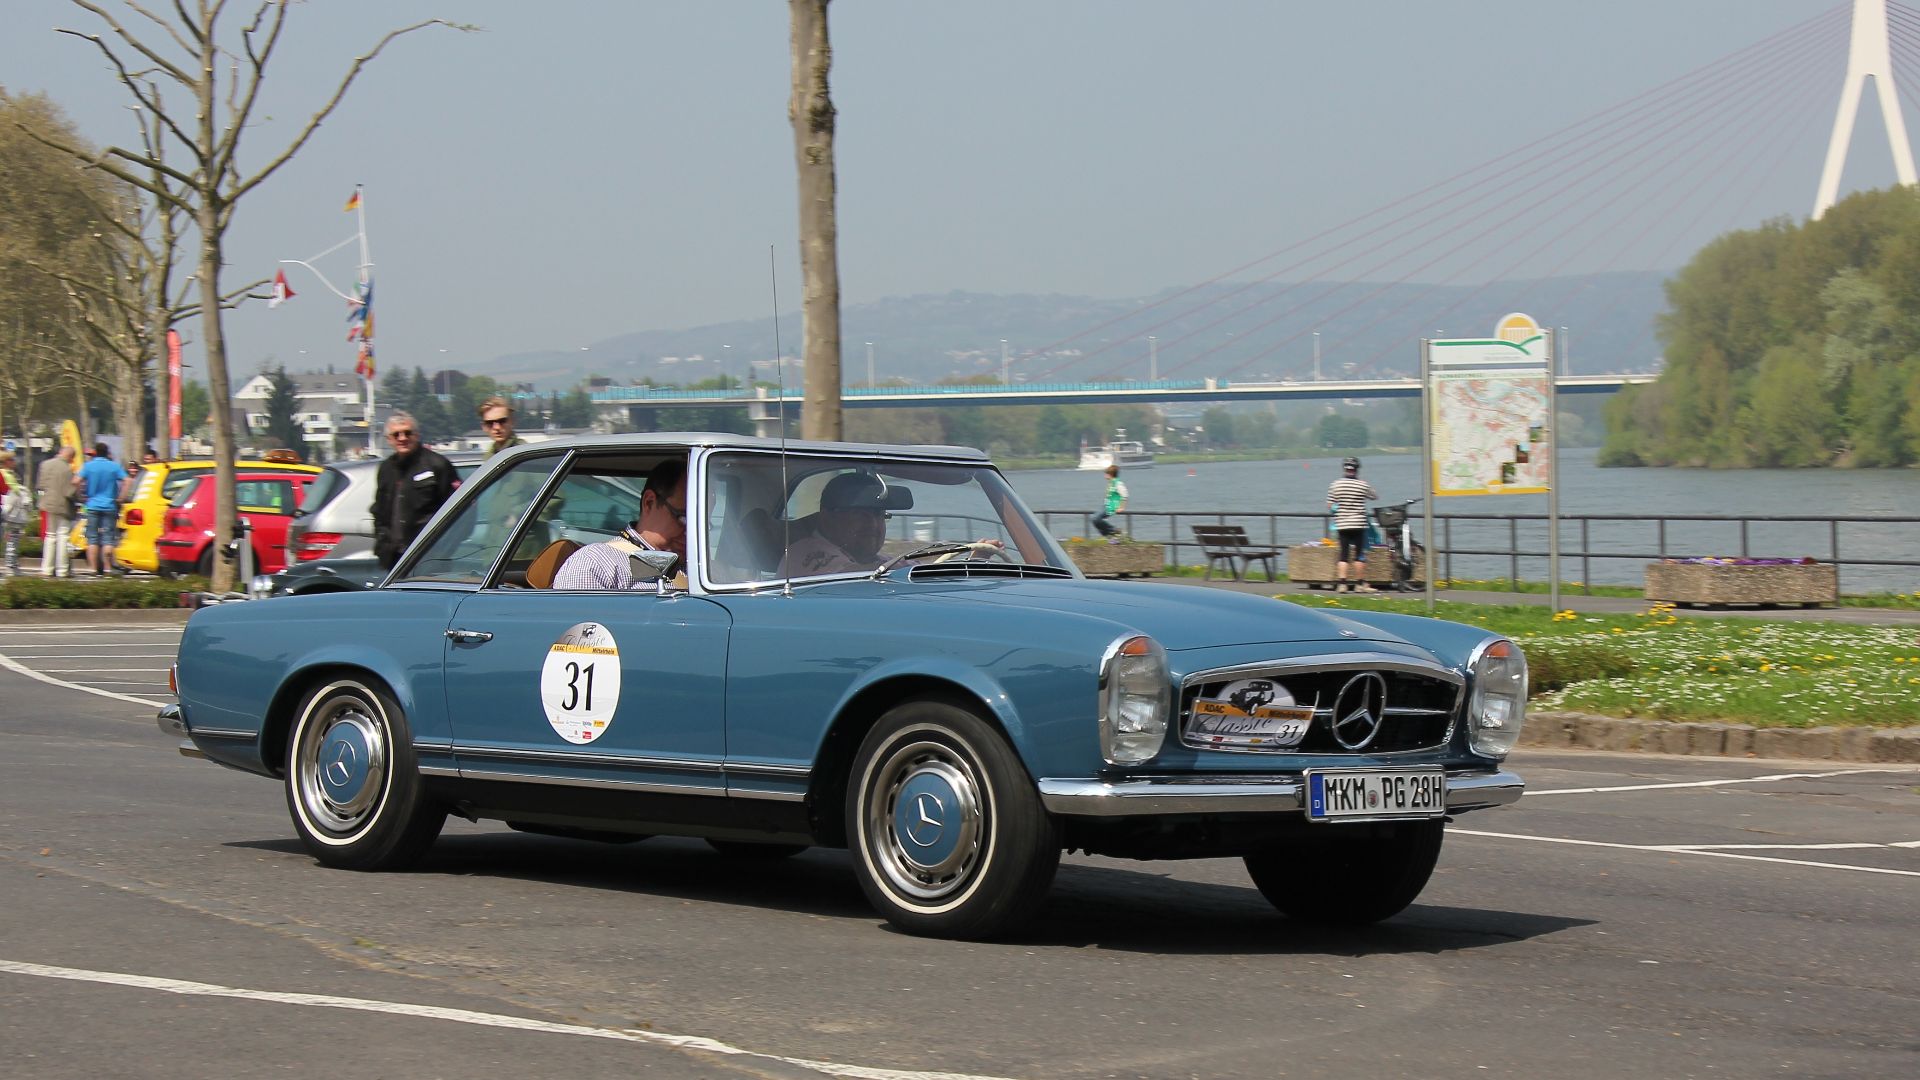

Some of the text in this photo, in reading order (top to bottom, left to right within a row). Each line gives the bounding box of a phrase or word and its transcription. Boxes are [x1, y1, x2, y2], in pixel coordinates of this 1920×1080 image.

[561, 661, 595, 711] 31
[1203, 703, 1225, 714] ADAC
[1197, 714, 1272, 735] Classic
[1277, 724, 1300, 739] 31
[1324, 775, 1442, 811] MKM PG 28H
